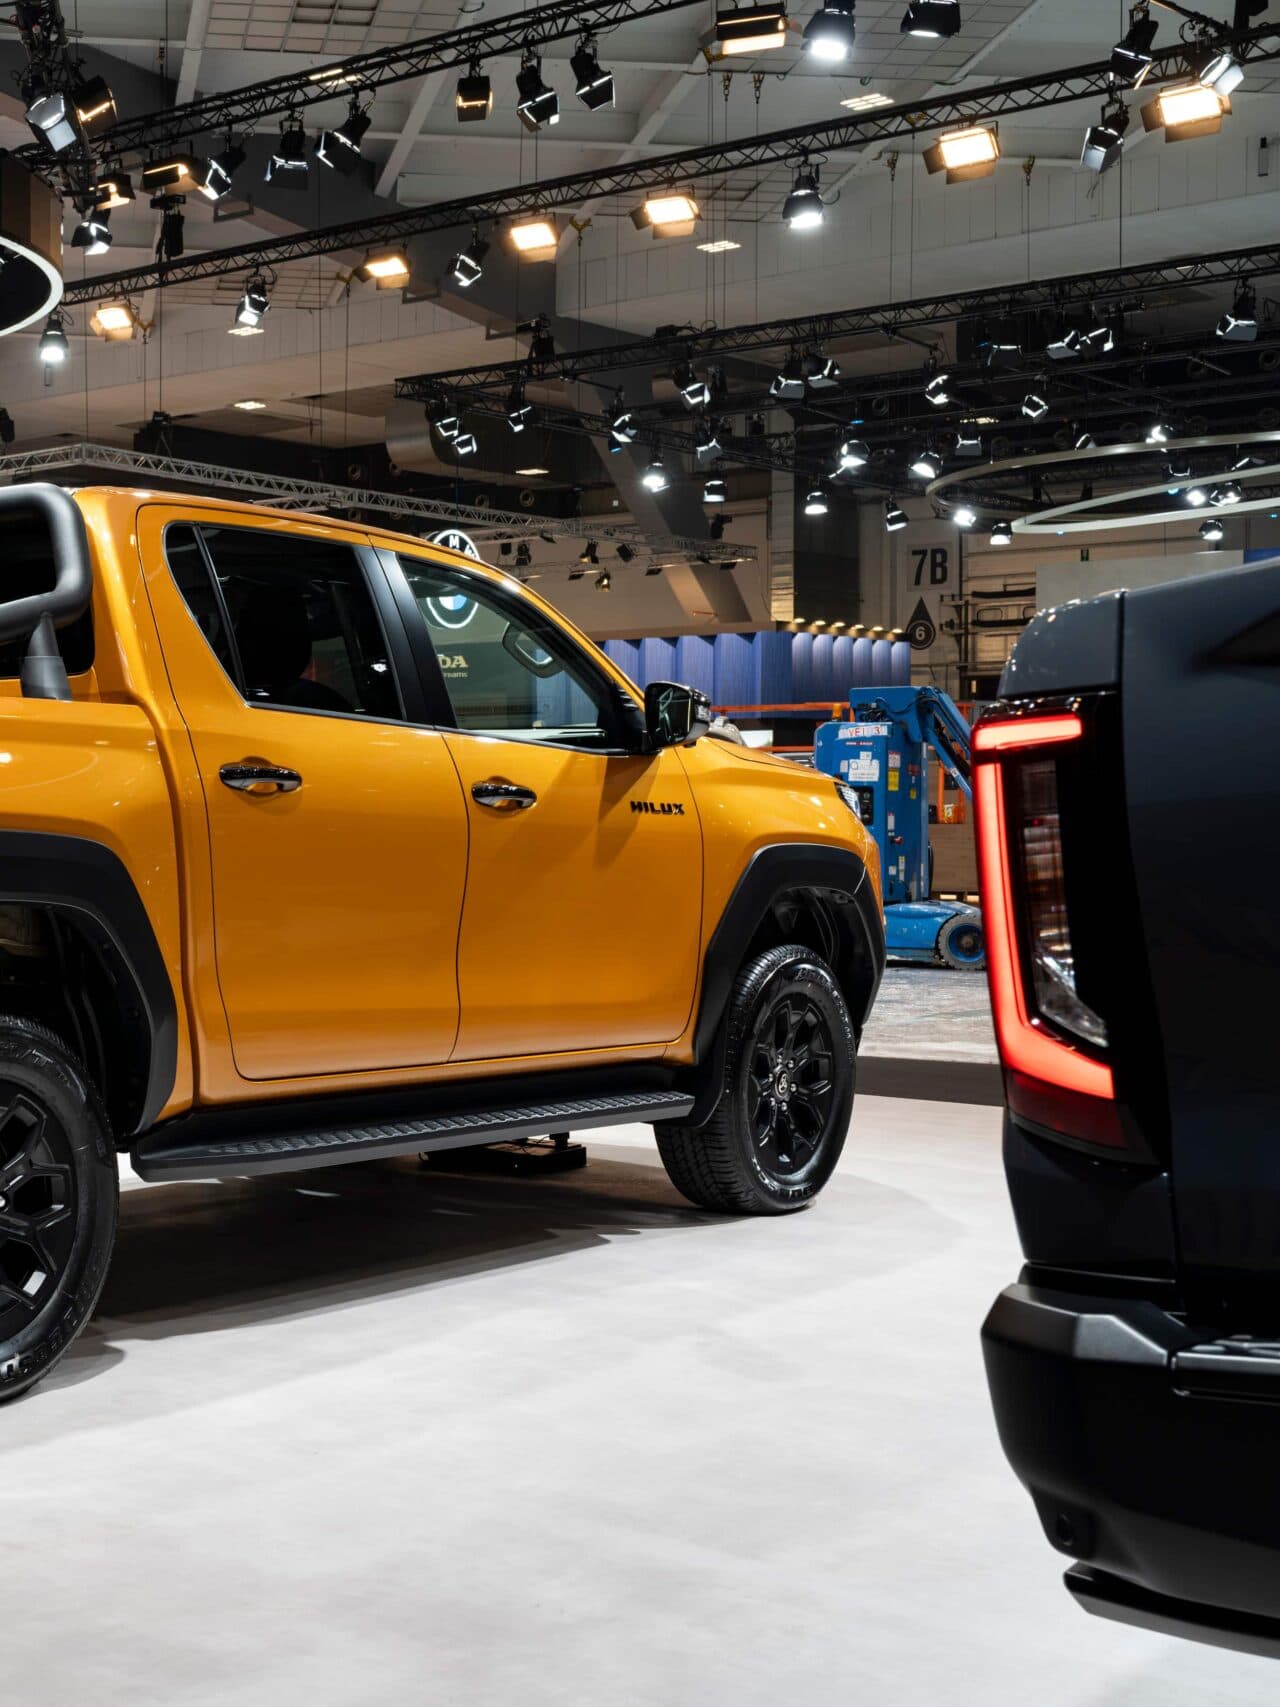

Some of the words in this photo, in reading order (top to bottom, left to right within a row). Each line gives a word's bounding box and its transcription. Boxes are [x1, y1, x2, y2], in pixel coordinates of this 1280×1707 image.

[912, 548, 948, 586] 7B
[915, 626, 926, 641] 6
[630, 801, 685, 815] HILUX
